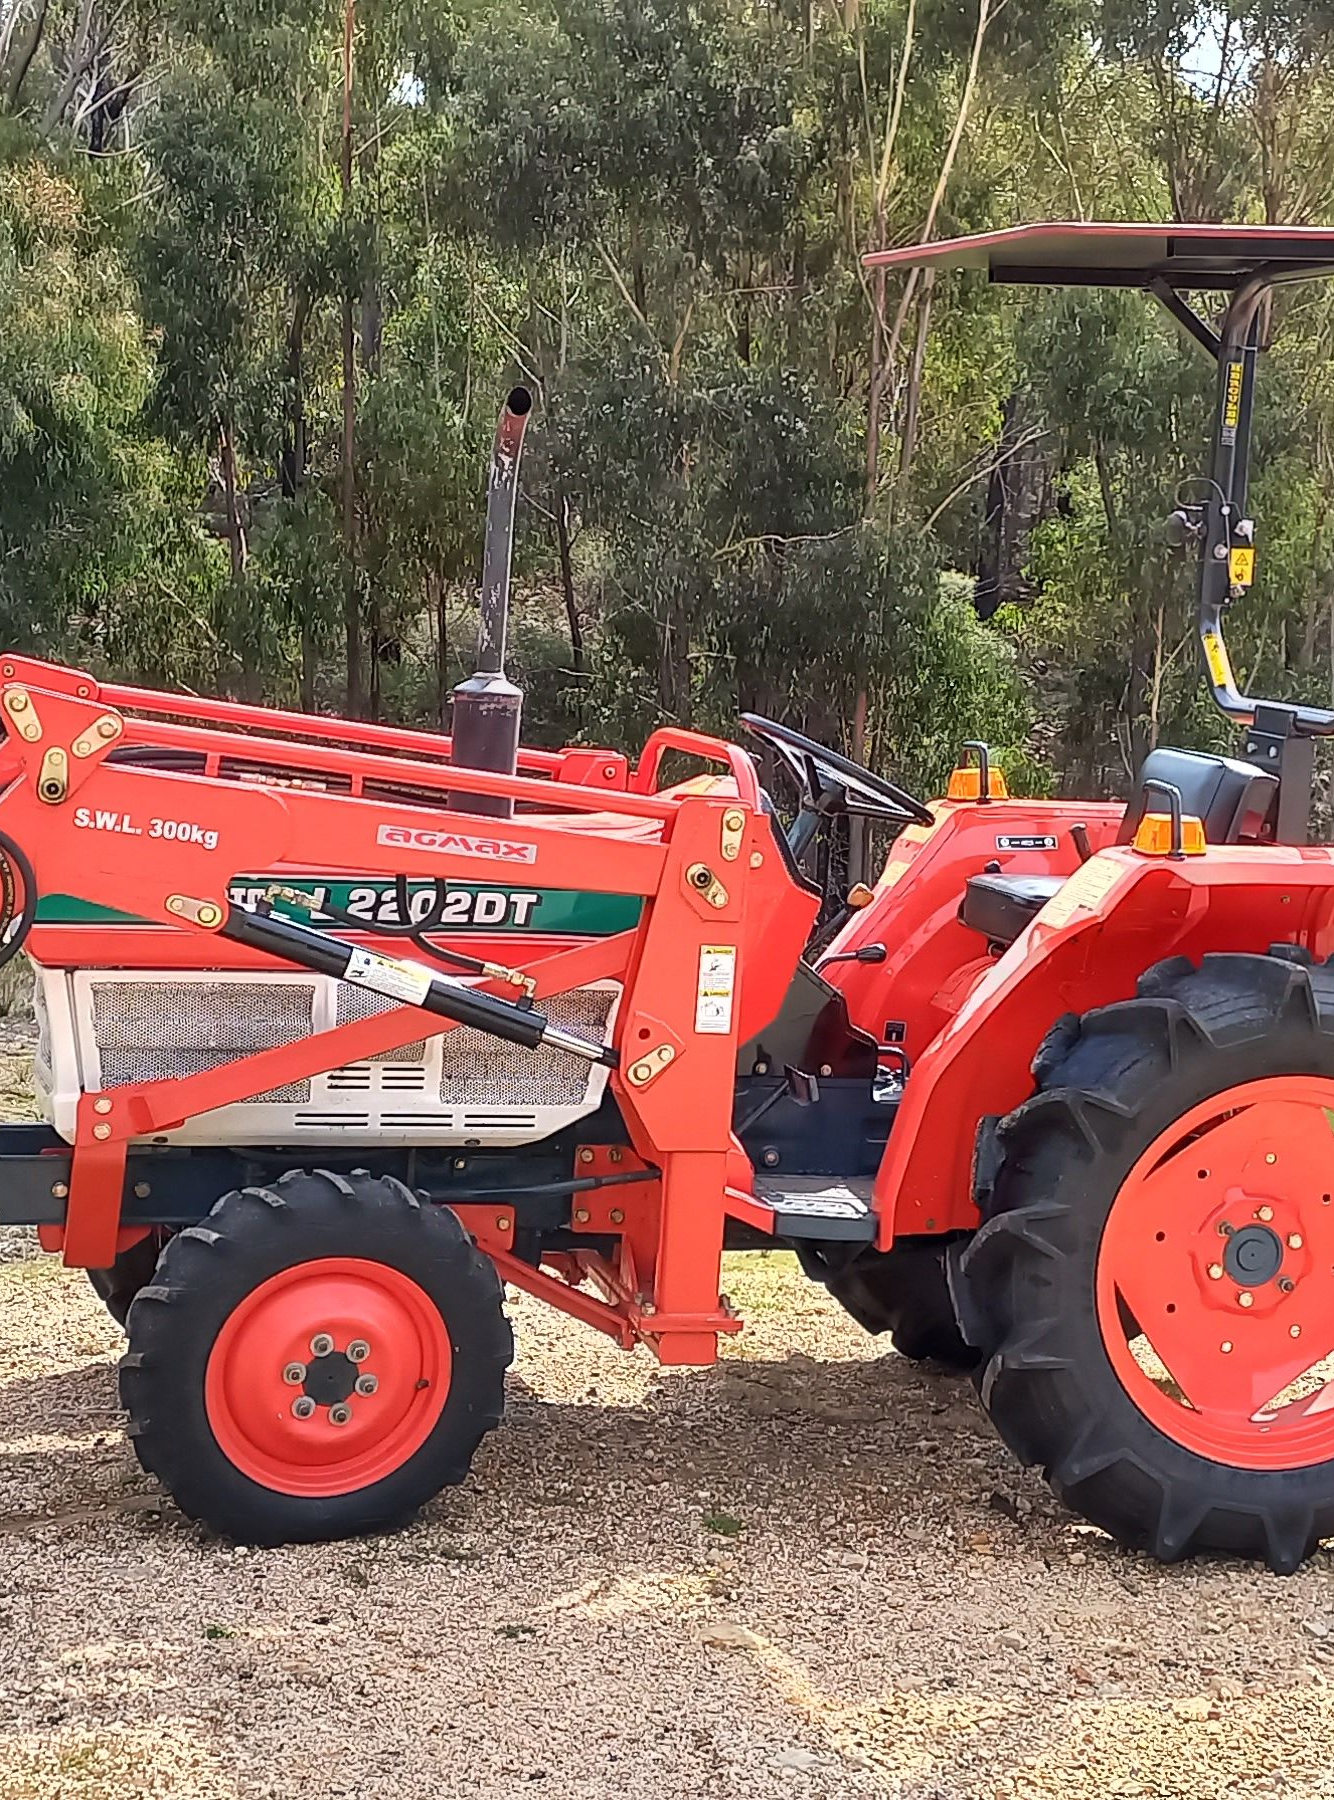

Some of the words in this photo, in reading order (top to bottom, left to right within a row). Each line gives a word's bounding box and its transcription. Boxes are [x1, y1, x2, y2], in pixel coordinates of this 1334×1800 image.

[74, 808, 142, 835] S.W.L.
[148, 818, 218, 850] 300kg
[347, 888, 537, 924] 2202DT
